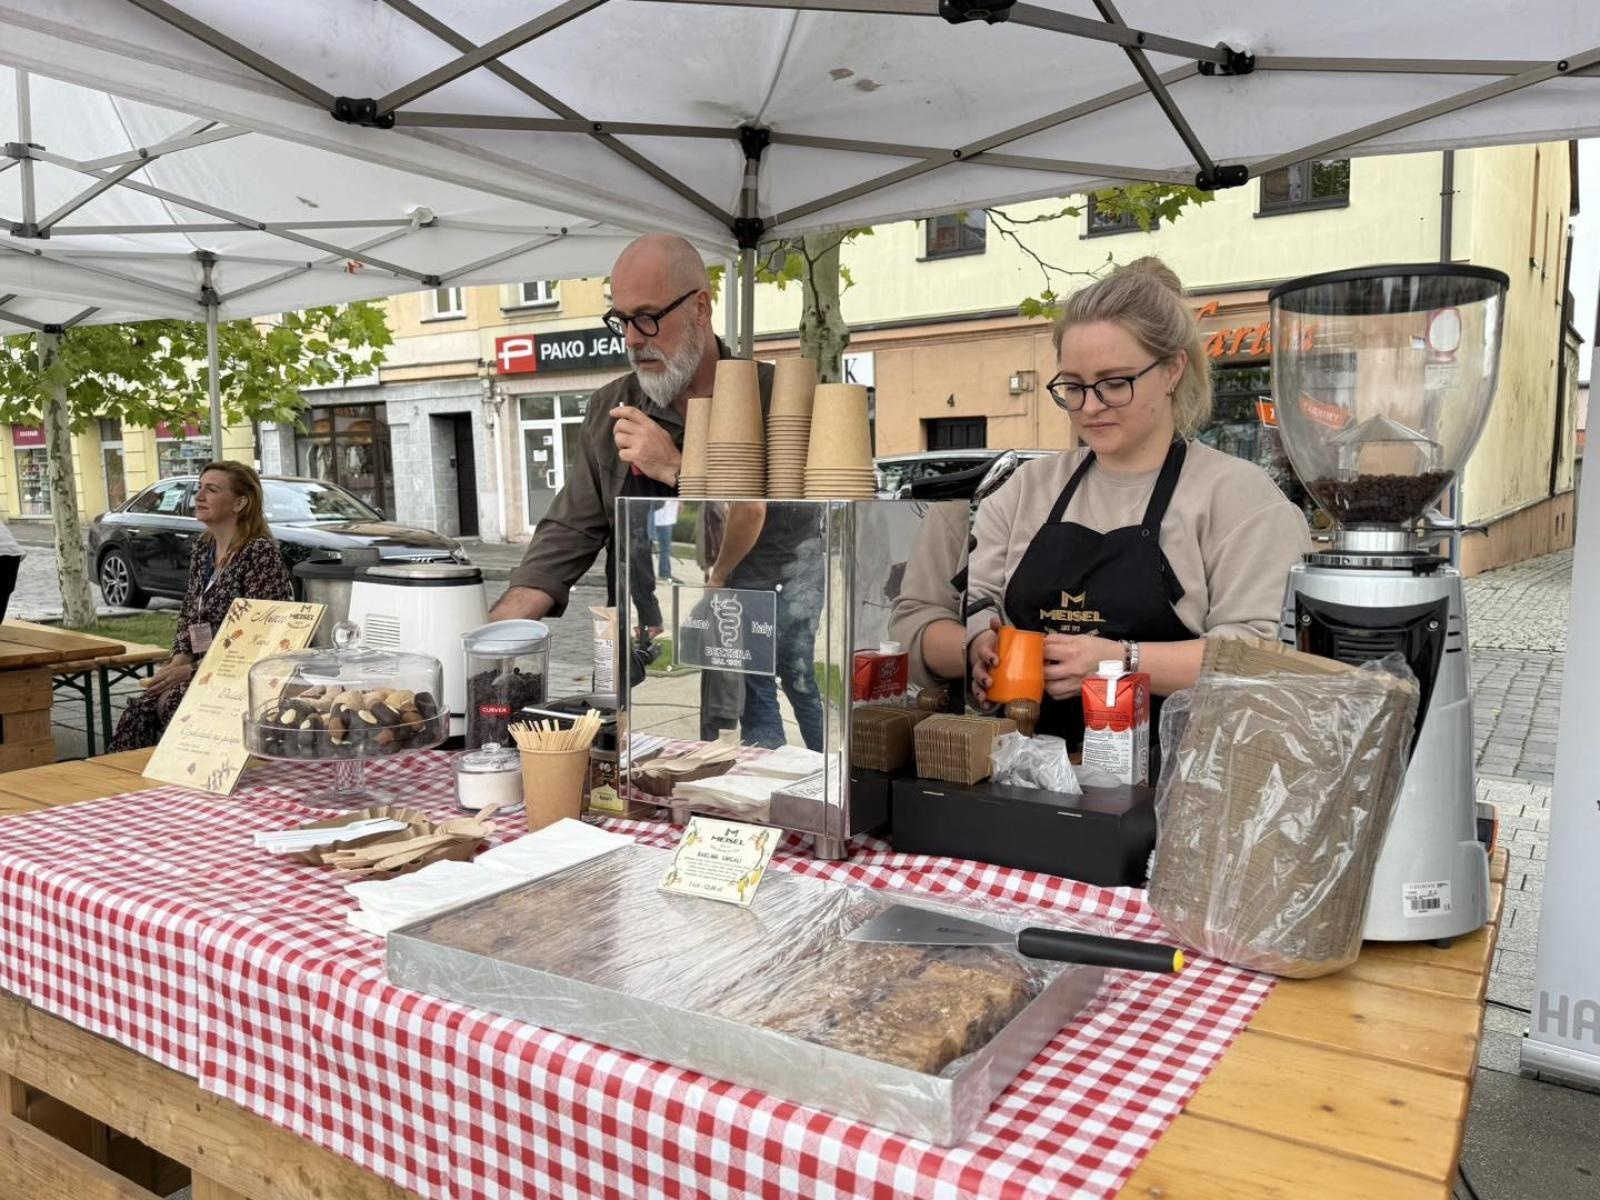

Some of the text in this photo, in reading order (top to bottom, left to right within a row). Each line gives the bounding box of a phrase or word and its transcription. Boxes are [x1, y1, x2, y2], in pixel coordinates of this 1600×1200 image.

[540, 340, 584, 360] PAKO
[1039, 608, 1107, 623] MEISEL
[710, 835, 745, 847] MEISEL
